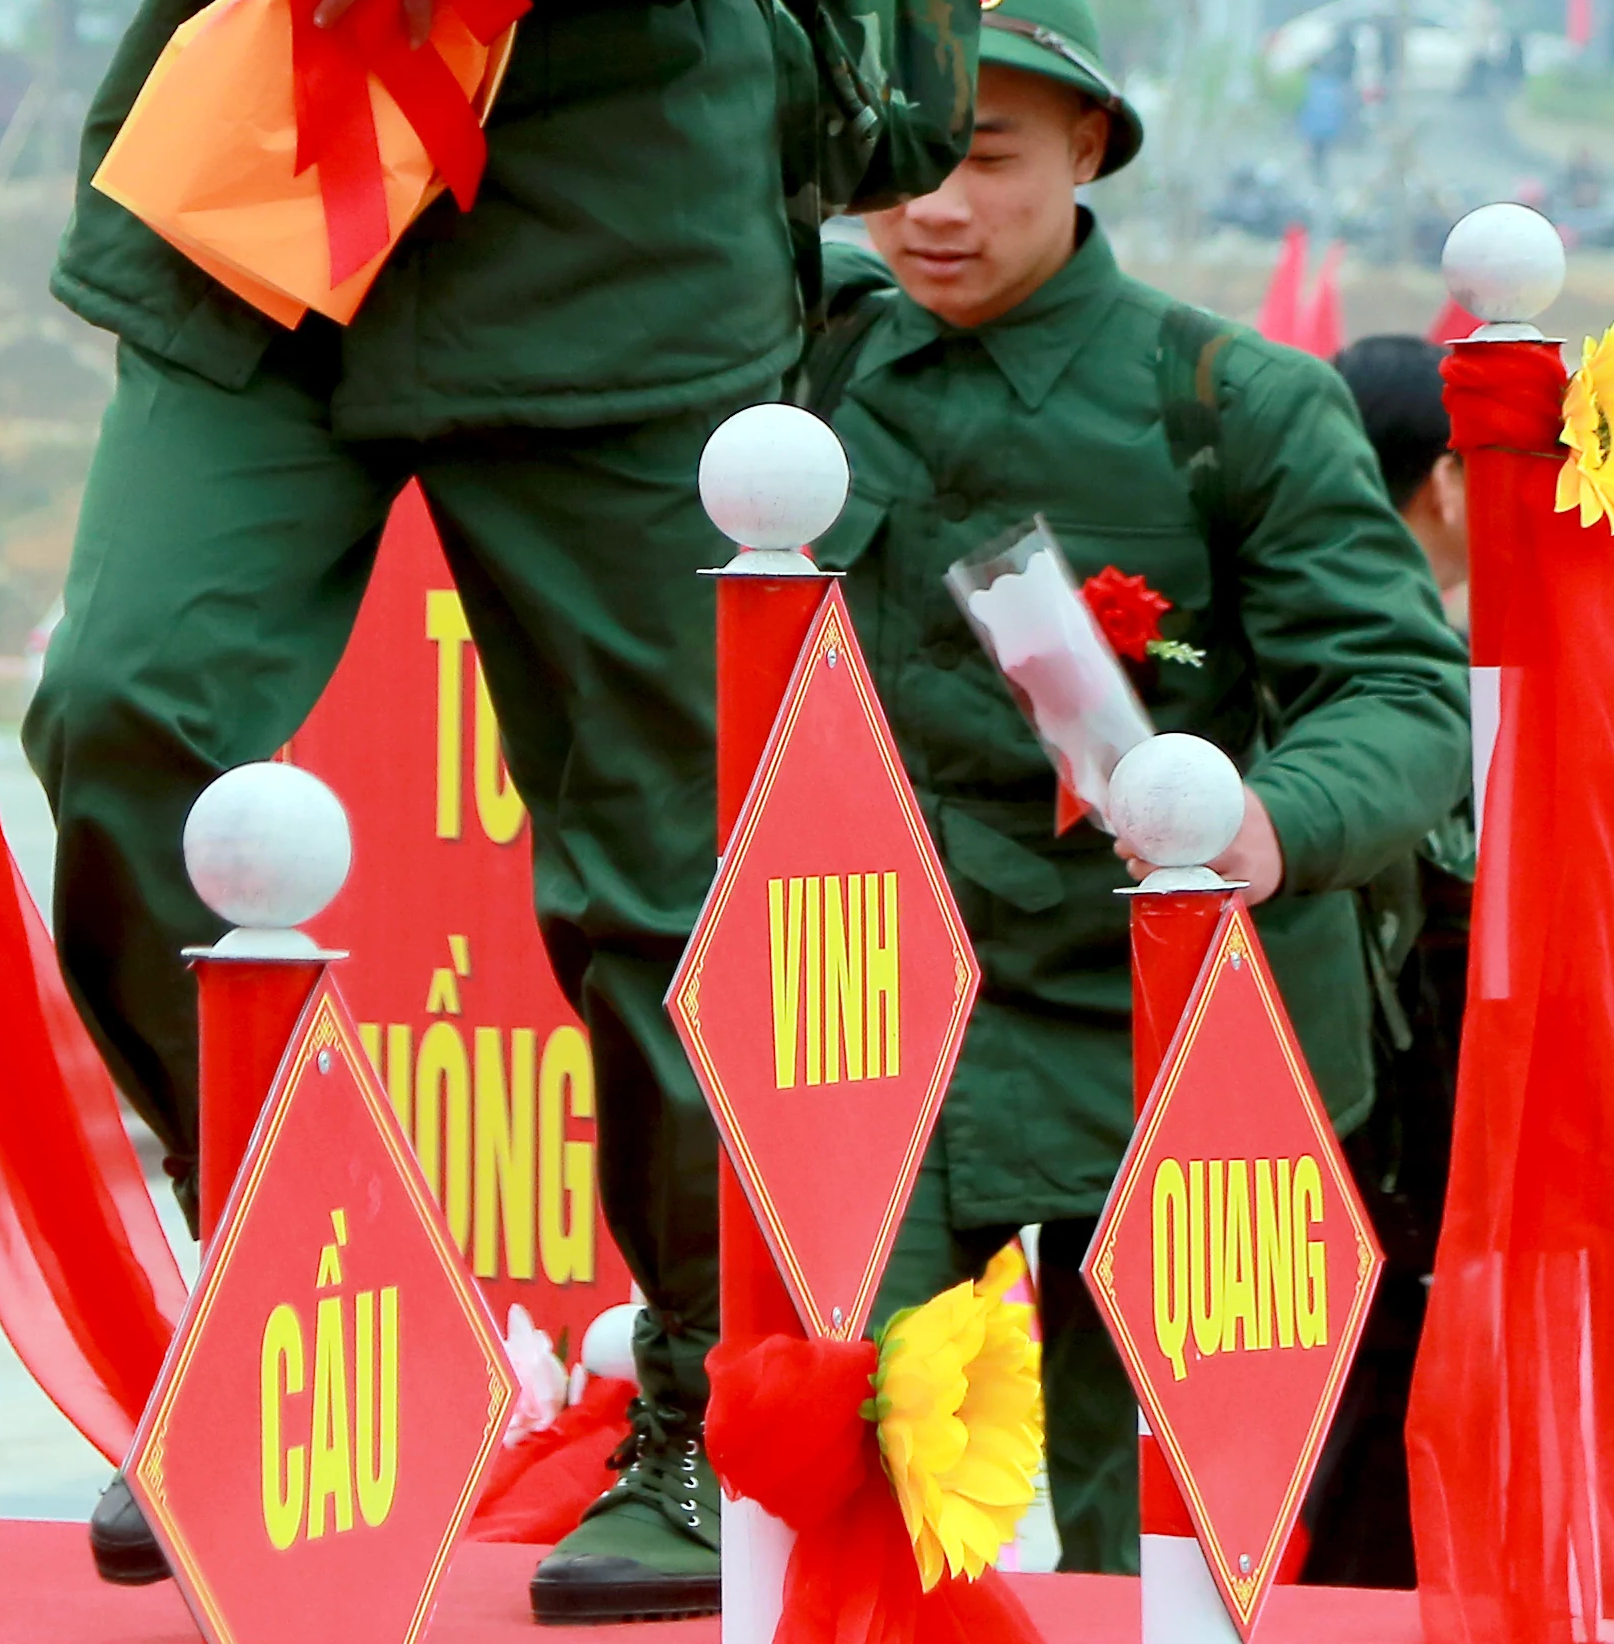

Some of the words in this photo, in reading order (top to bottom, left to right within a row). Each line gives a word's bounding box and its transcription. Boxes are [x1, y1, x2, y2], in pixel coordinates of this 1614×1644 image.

[767, 870, 902, 1092] VINH
[258, 1208, 400, 1551] CẦU
[1150, 1156, 1329, 1382] QUANG
